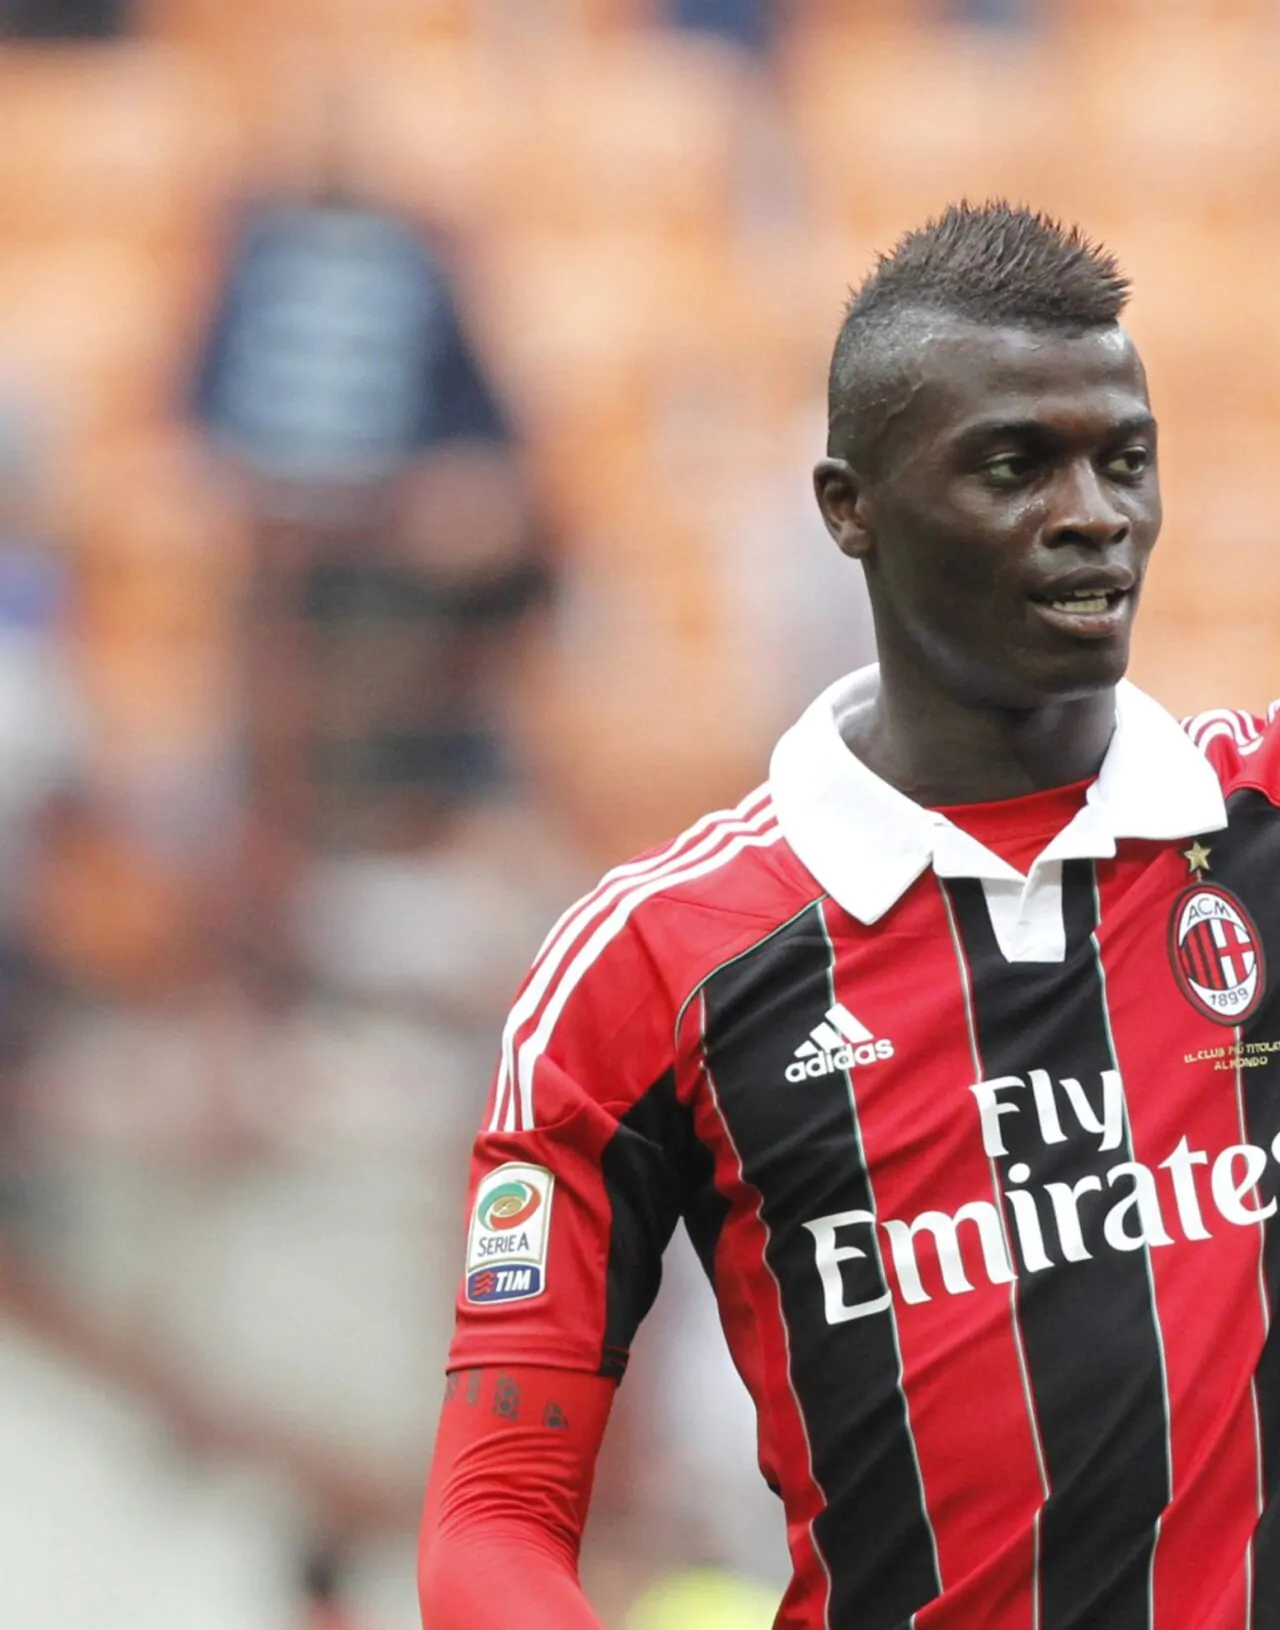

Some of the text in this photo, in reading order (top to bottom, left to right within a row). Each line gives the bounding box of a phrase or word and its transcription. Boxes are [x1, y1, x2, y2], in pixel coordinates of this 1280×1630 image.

[1187, 898, 1231, 927] ACM
[1209, 987, 1249, 1008] 1899
[784, 1038, 895, 1082] adidas
[1197, 1046, 1225, 1060] CLUB
[1214, 1060, 1229, 1070] AL
[970, 1068, 1122, 1158] Fly
[477, 1232, 530, 1257] SERIE A
[495, 1269, 532, 1292] TIM
